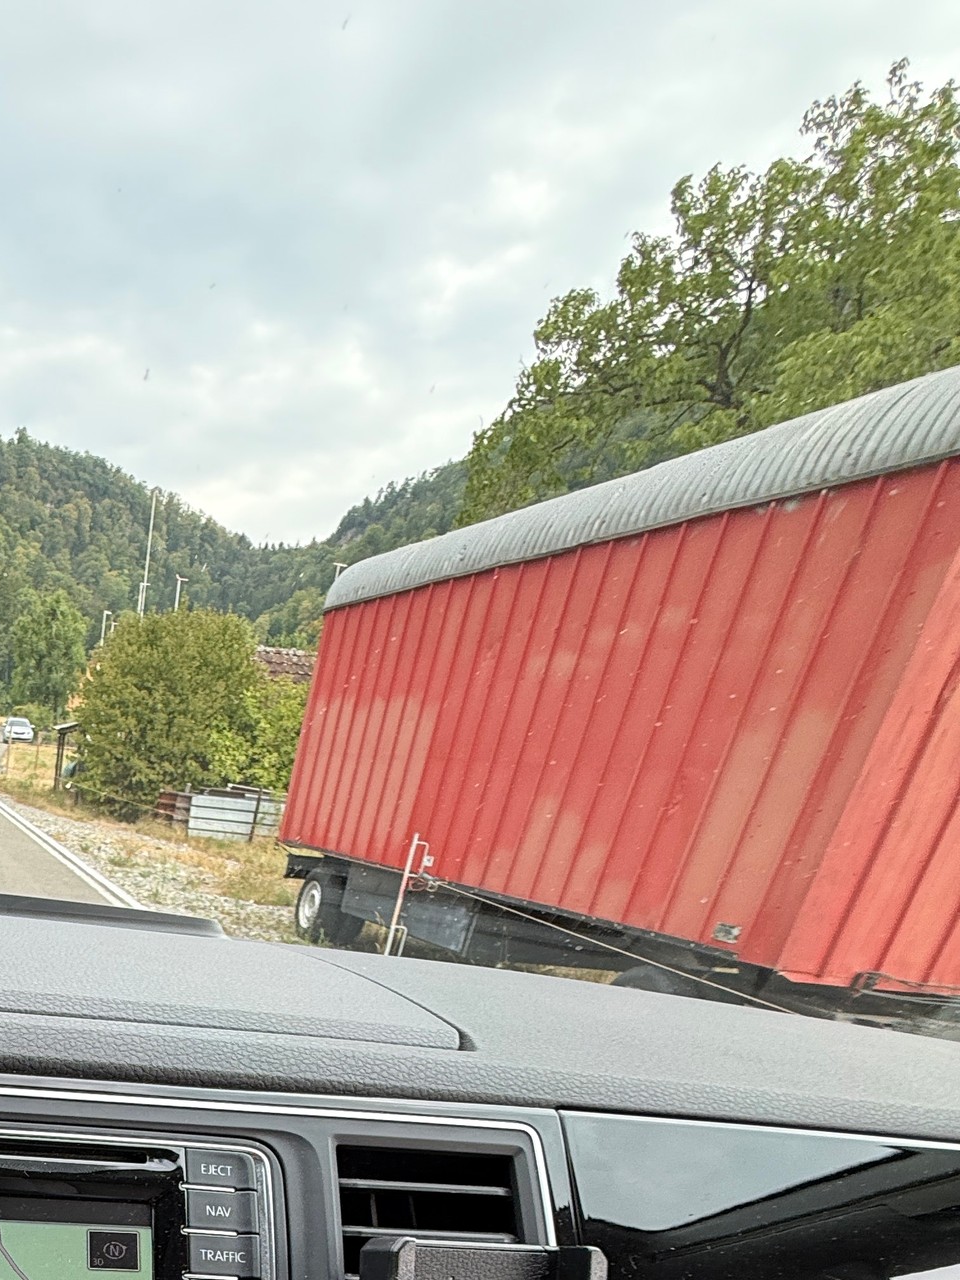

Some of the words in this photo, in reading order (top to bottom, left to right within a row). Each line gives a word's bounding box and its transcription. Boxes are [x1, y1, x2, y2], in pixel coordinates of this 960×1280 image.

[200, 1163, 233, 1177] EJECT
[205, 1205, 232, 1218] NAV
[92, 1257, 104, 1266] 3D
[199, 1249, 246, 1263] TRAFFIC
